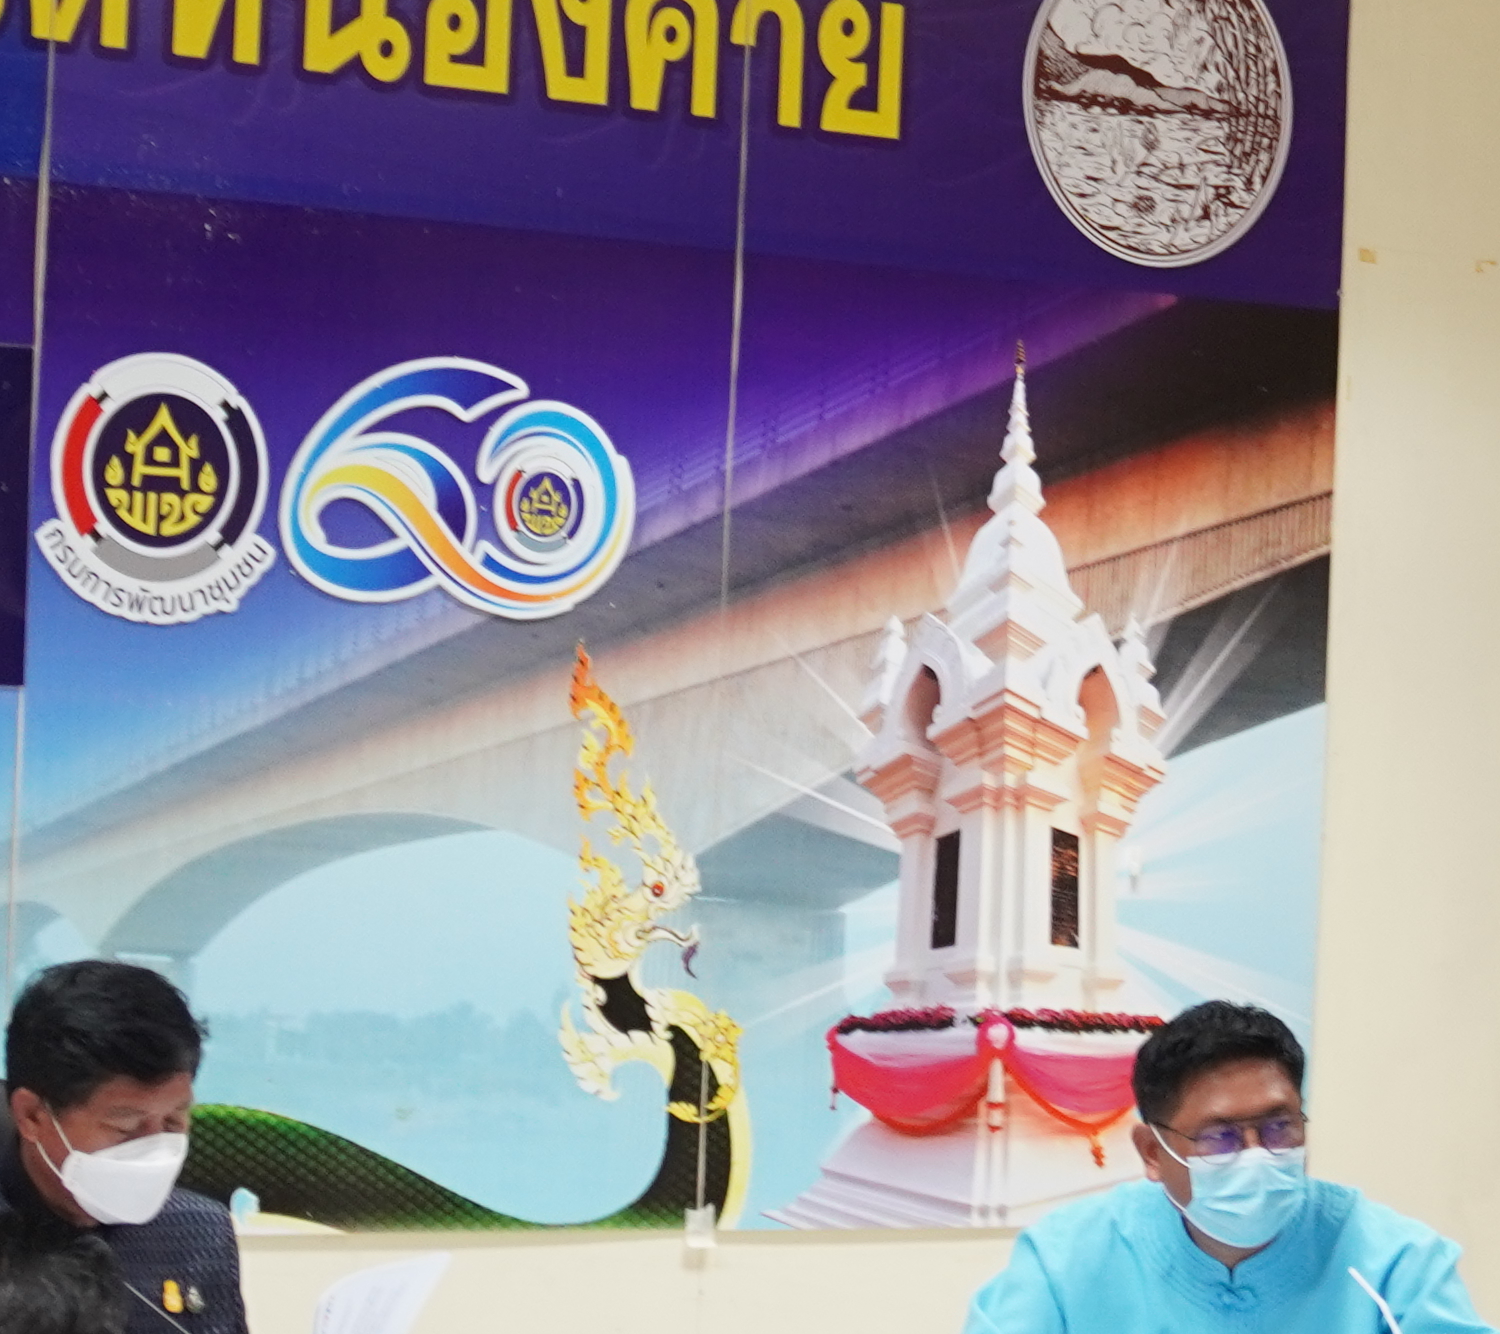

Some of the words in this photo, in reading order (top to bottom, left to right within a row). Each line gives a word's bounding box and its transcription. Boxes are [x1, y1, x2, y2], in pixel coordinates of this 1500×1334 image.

[44, 527, 269, 617] กรมการพัฒนาชุมชน
